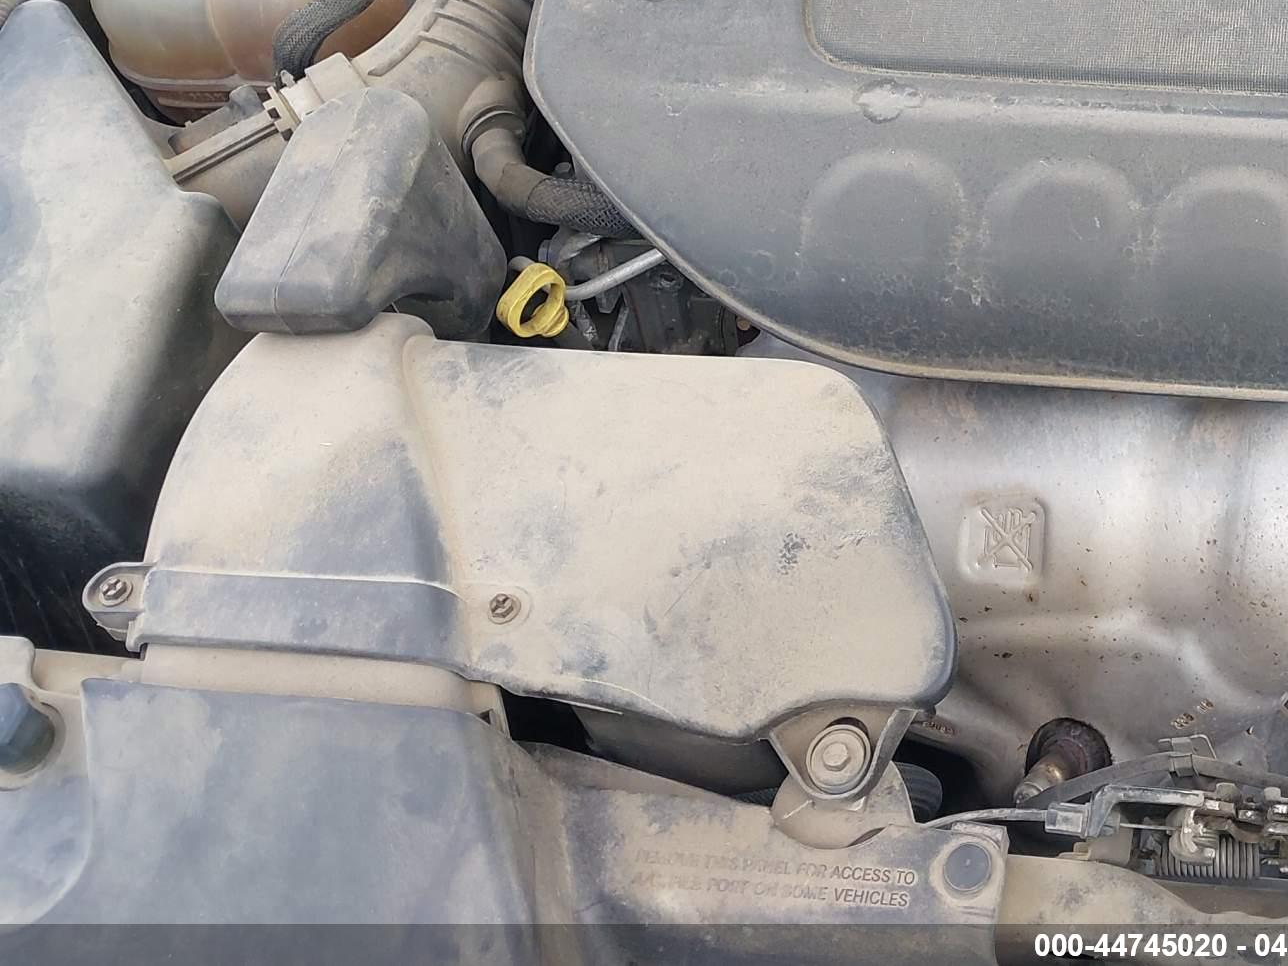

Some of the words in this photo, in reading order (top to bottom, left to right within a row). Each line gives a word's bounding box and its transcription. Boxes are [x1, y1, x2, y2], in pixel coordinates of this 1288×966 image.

[830, 865, 892, 883] ACCESS
[896, 869, 916, 886] TO
[834, 887, 909, 907] VEHICLES
